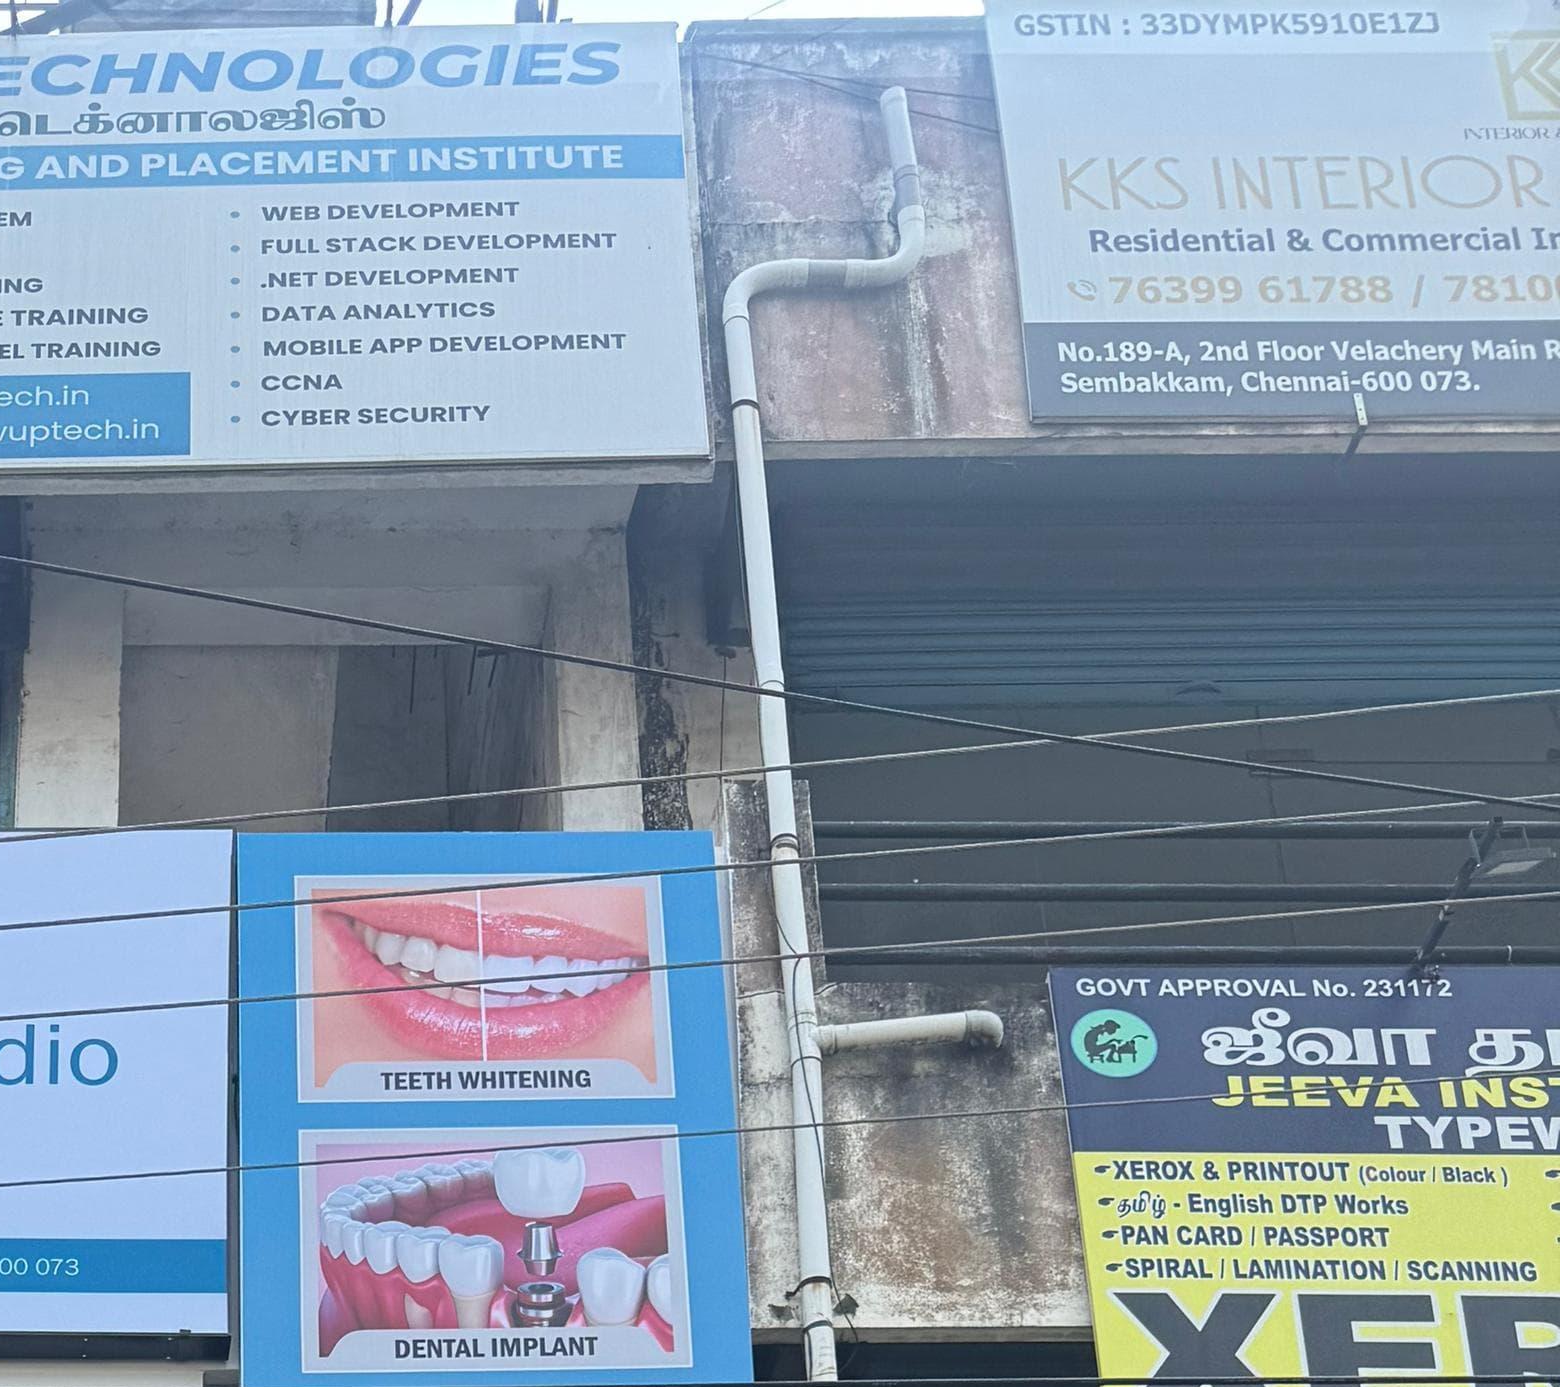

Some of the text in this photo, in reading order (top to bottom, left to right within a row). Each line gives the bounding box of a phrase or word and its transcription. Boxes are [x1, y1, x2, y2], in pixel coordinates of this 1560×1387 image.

[1014, 14, 1111, 36] GSTIN
[1463, 127, 1549, 140] INTERIOR
[36, 154, 130, 180] AND
[141, 148, 397, 177] PLACEMENT
[408, 145, 623, 171] INSTITUTE
[1058, 157, 1190, 211] KKS
[261, 202, 520, 222] WEB DEVELOPMENT
[1089, 227, 1521, 254] Residential Commercial
[1109, 275, 1393, 305] 76399 61788
[262, 302, 496, 322] DATA ANALYTICS
[1058, 340, 1537, 367] No.189-A, 2nd Floor Velachery Main
[261, 375, 342, 391] CCNA
[1061, 371, 1480, 397] Sembakkam, Chennai-600 073.
[1076, 979, 1452, 996] GOVT APPROVAL No. 231172
[1201, 1007, 1436, 1066] ஜீவா
[380, 1069, 592, 1091] TEETH WHITENING
[1212, 1076, 1419, 1108] JEEVA
[1113, 1161, 1350, 1181] XEROX PRINTOUT
[1188, 1194, 1408, 1216] English DTP Works
[1121, 1227, 1390, 1247] PAN CARD PASSPORT
[35, 1258, 80, 1277] 073
[1124, 1259, 1538, 1281] SPIRAL LAMINATION SCANNING
[394, 1337, 598, 1359] DENTAL IMPLANT
